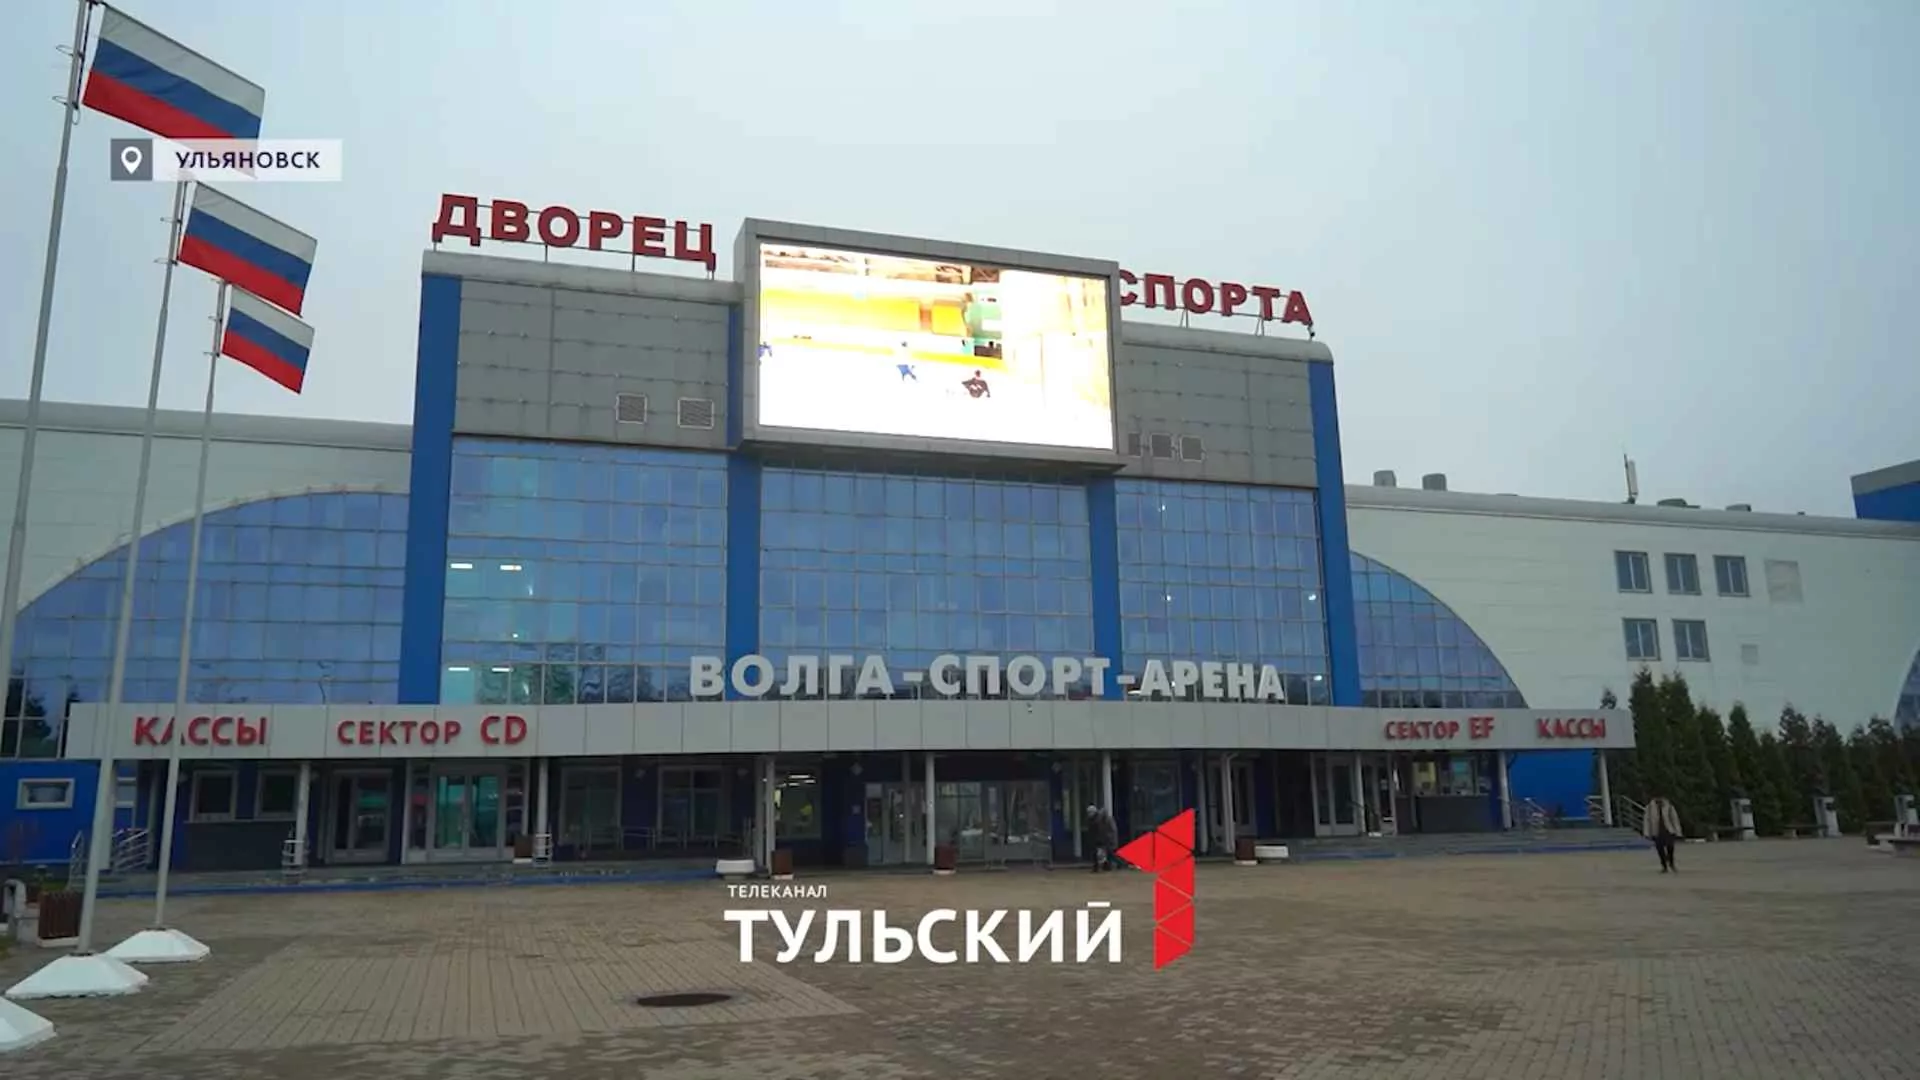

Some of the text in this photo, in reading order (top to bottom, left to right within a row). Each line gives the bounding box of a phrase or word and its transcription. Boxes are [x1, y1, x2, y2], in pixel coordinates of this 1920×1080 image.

[432, 193, 1313, 326] ДВОРЕЦ СПОРТА
[690, 654, 1285, 700] ВОЛГА-СПОРТ-АРЕНА
[337, 715, 528, 746] СЕКТОР CD
[1384, 716, 1495, 740] СЕКТОР EF
[1536, 717, 1606, 740] КАССЫ
